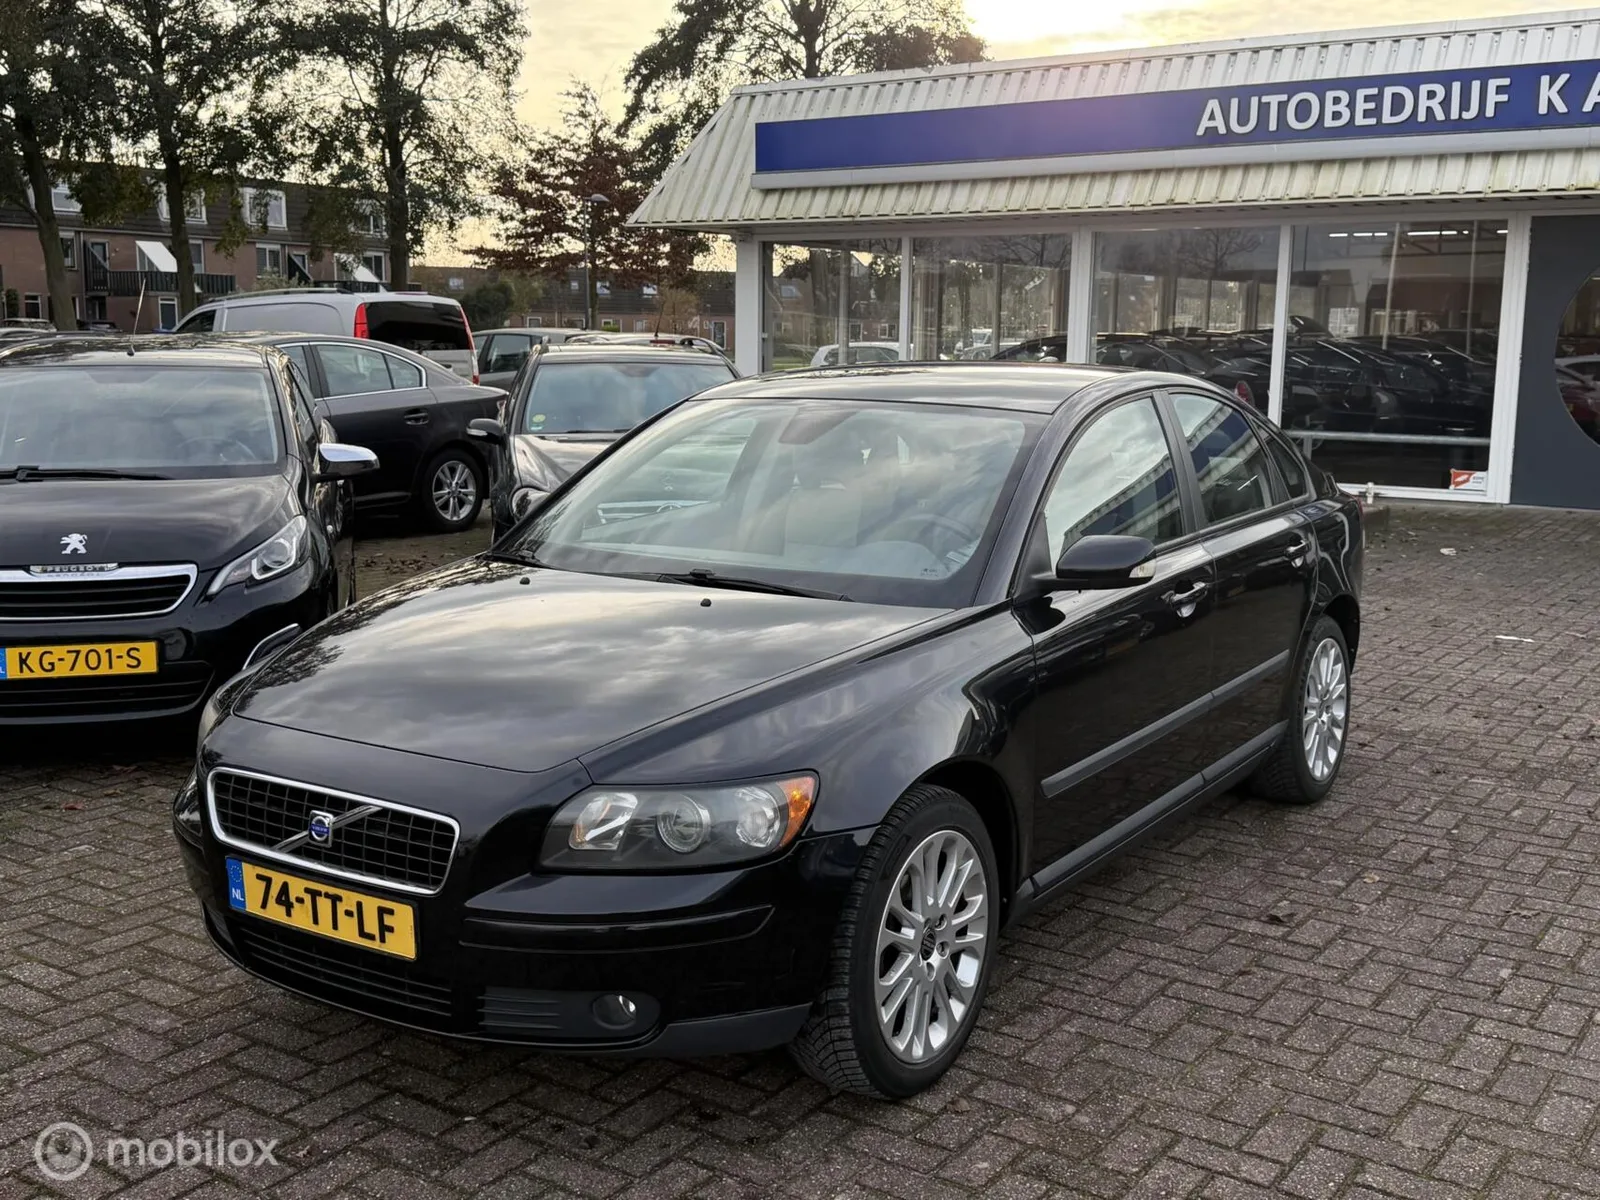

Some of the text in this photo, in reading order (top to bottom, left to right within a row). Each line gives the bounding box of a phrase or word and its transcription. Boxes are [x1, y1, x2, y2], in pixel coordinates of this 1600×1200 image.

[1196, 78, 1511, 136] AUTOBEDRIJF
[18, 647, 142, 674] KG-701-S
[231, 887, 244, 901] NL
[256, 873, 395, 944] 74-TT-LF
